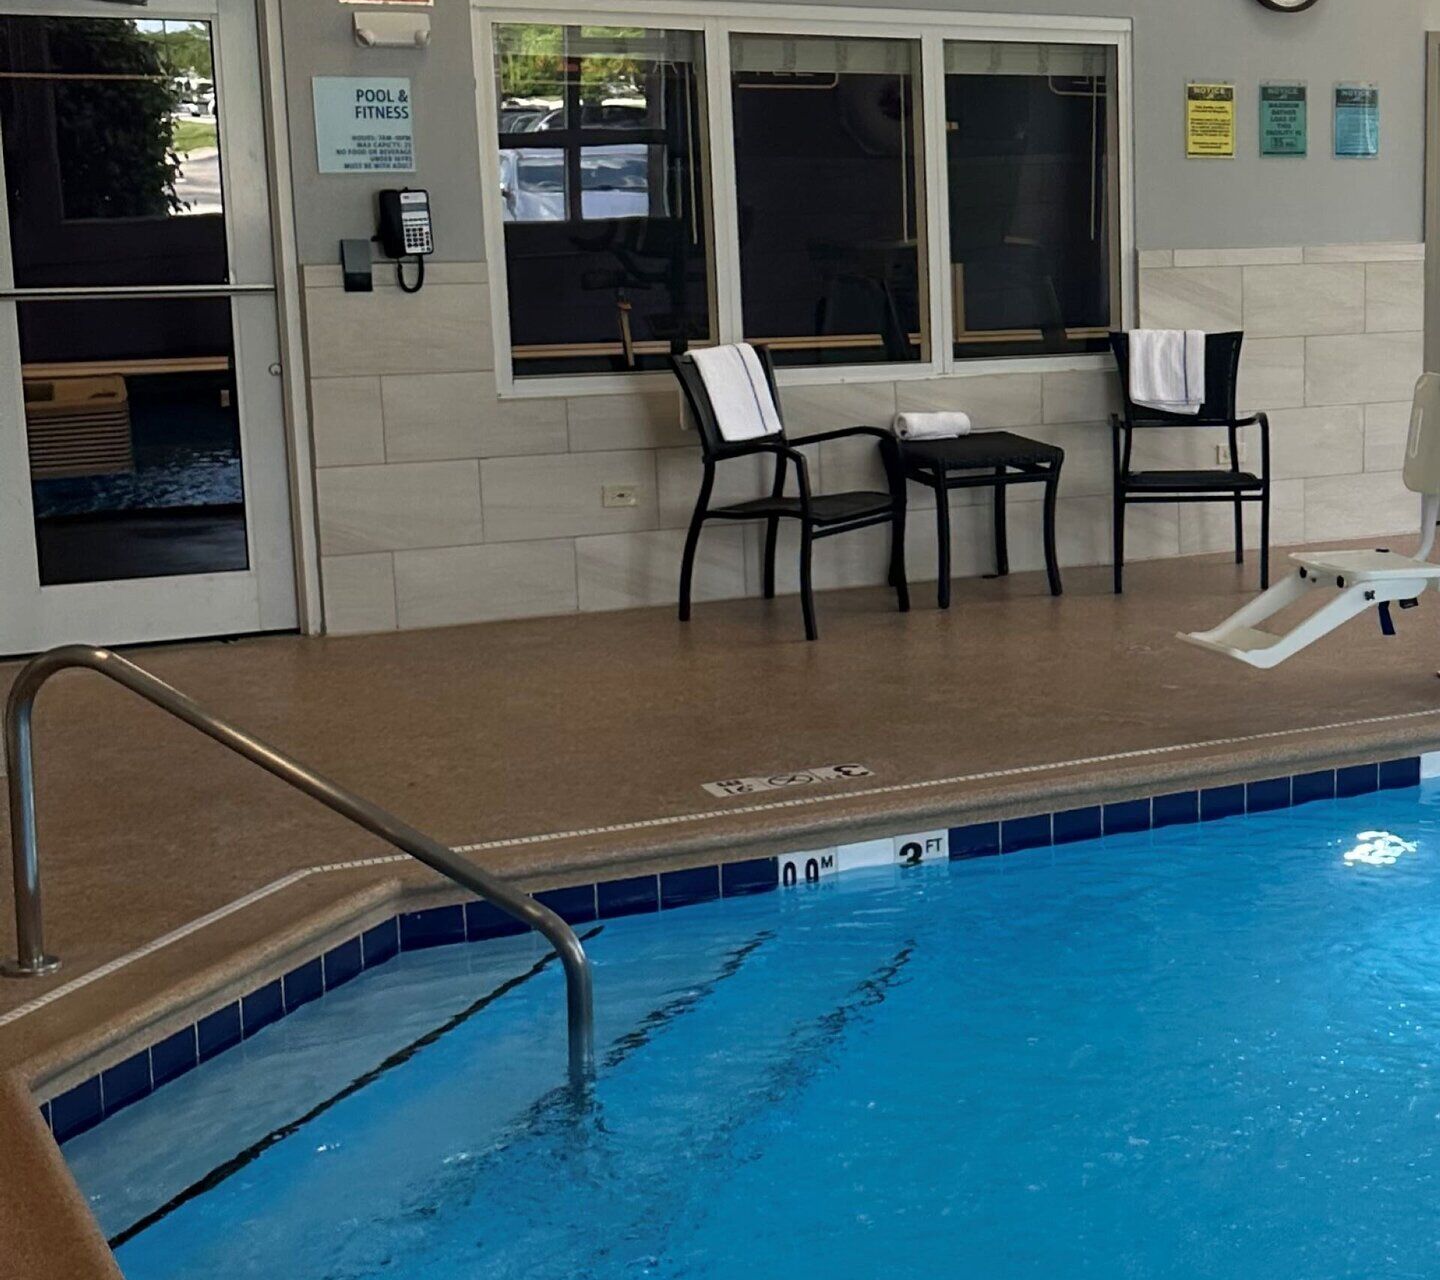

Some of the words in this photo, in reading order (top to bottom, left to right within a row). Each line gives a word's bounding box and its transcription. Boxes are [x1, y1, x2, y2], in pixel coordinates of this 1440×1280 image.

[356, 88, 395, 103] POOL
[397, 89, 409, 103] &
[355, 106, 410, 120] FITNESS
